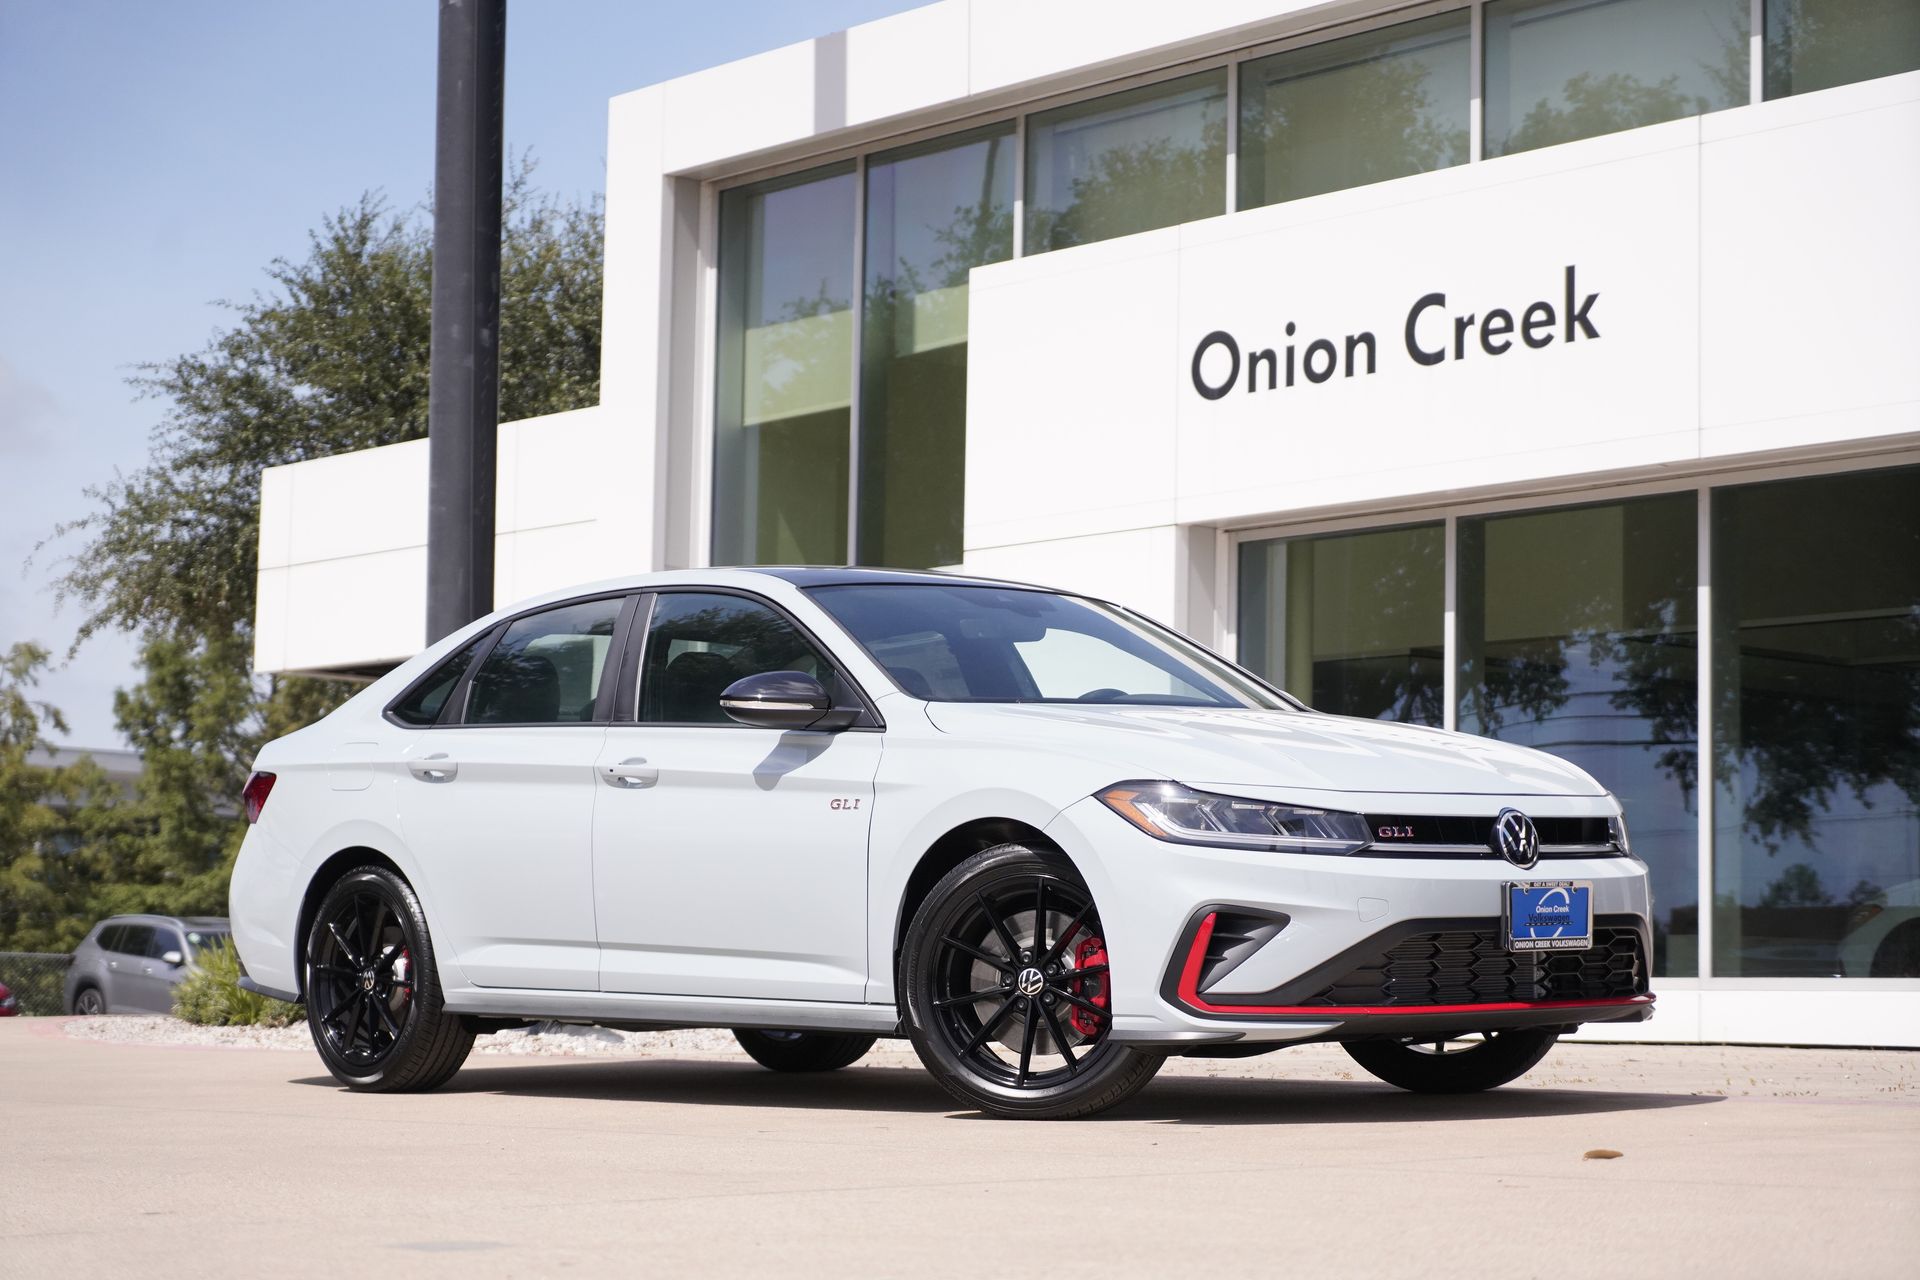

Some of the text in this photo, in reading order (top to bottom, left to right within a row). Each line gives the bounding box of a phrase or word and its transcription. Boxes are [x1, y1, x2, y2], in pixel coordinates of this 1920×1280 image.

[1191, 264, 1601, 401] Onion Creek
[830, 798, 861, 810] GLI
[1378, 825, 1415, 838] GLI
[1536, 904, 1570, 914] Onion Creek
[1528, 913, 1570, 923] Volkswagen
[1515, 939, 1589, 949] ONION CREEK VOLKSWAGEN
